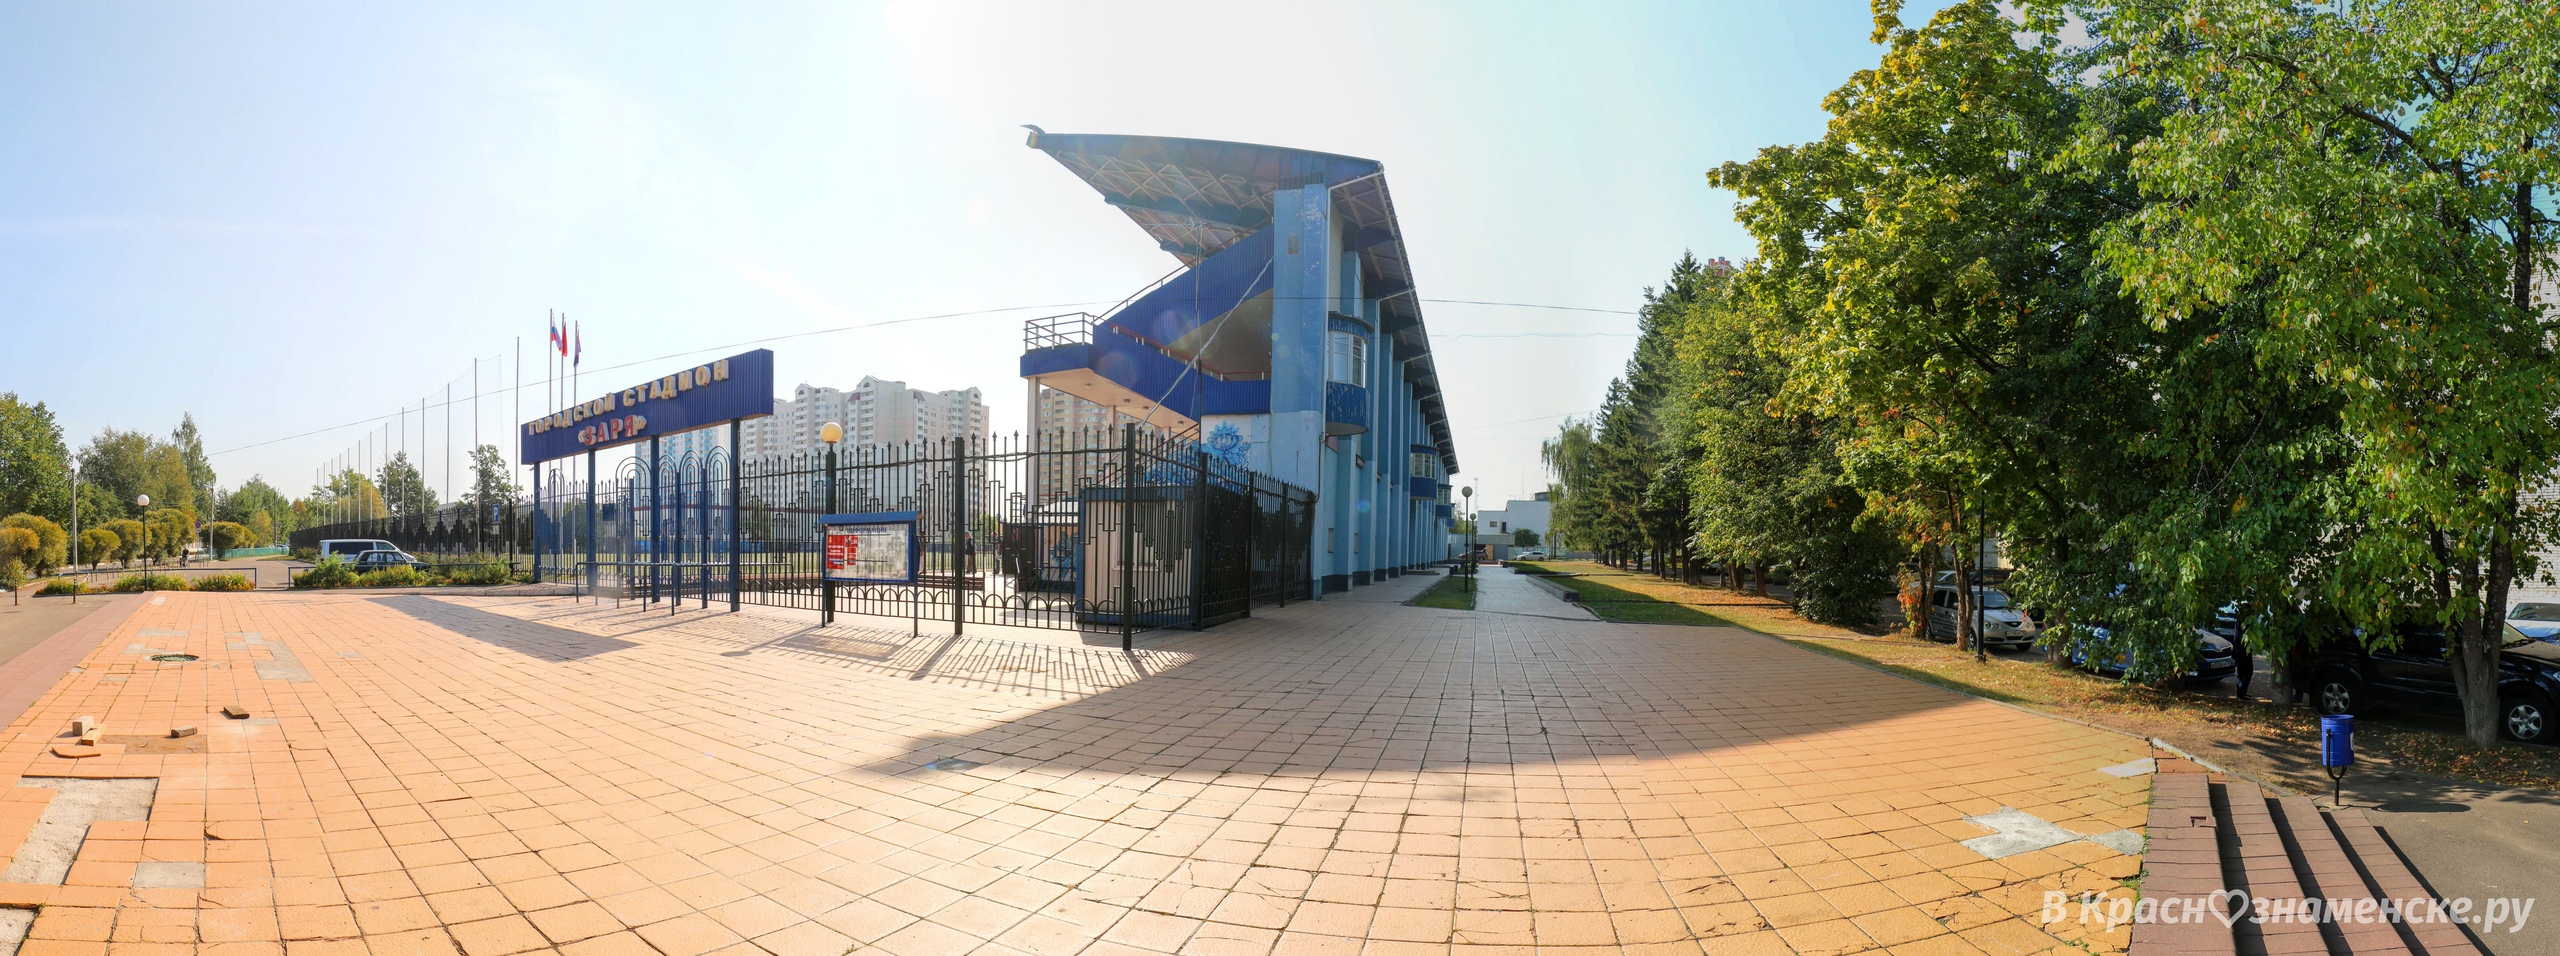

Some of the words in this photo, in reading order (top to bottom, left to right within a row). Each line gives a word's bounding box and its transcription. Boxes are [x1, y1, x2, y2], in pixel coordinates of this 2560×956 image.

[528, 392, 616, 436] ГОРОДСКОЙ
[622, 359, 729, 407] СТАДИОН
[577, 414, 647, 446] «ЗАРЯ»
